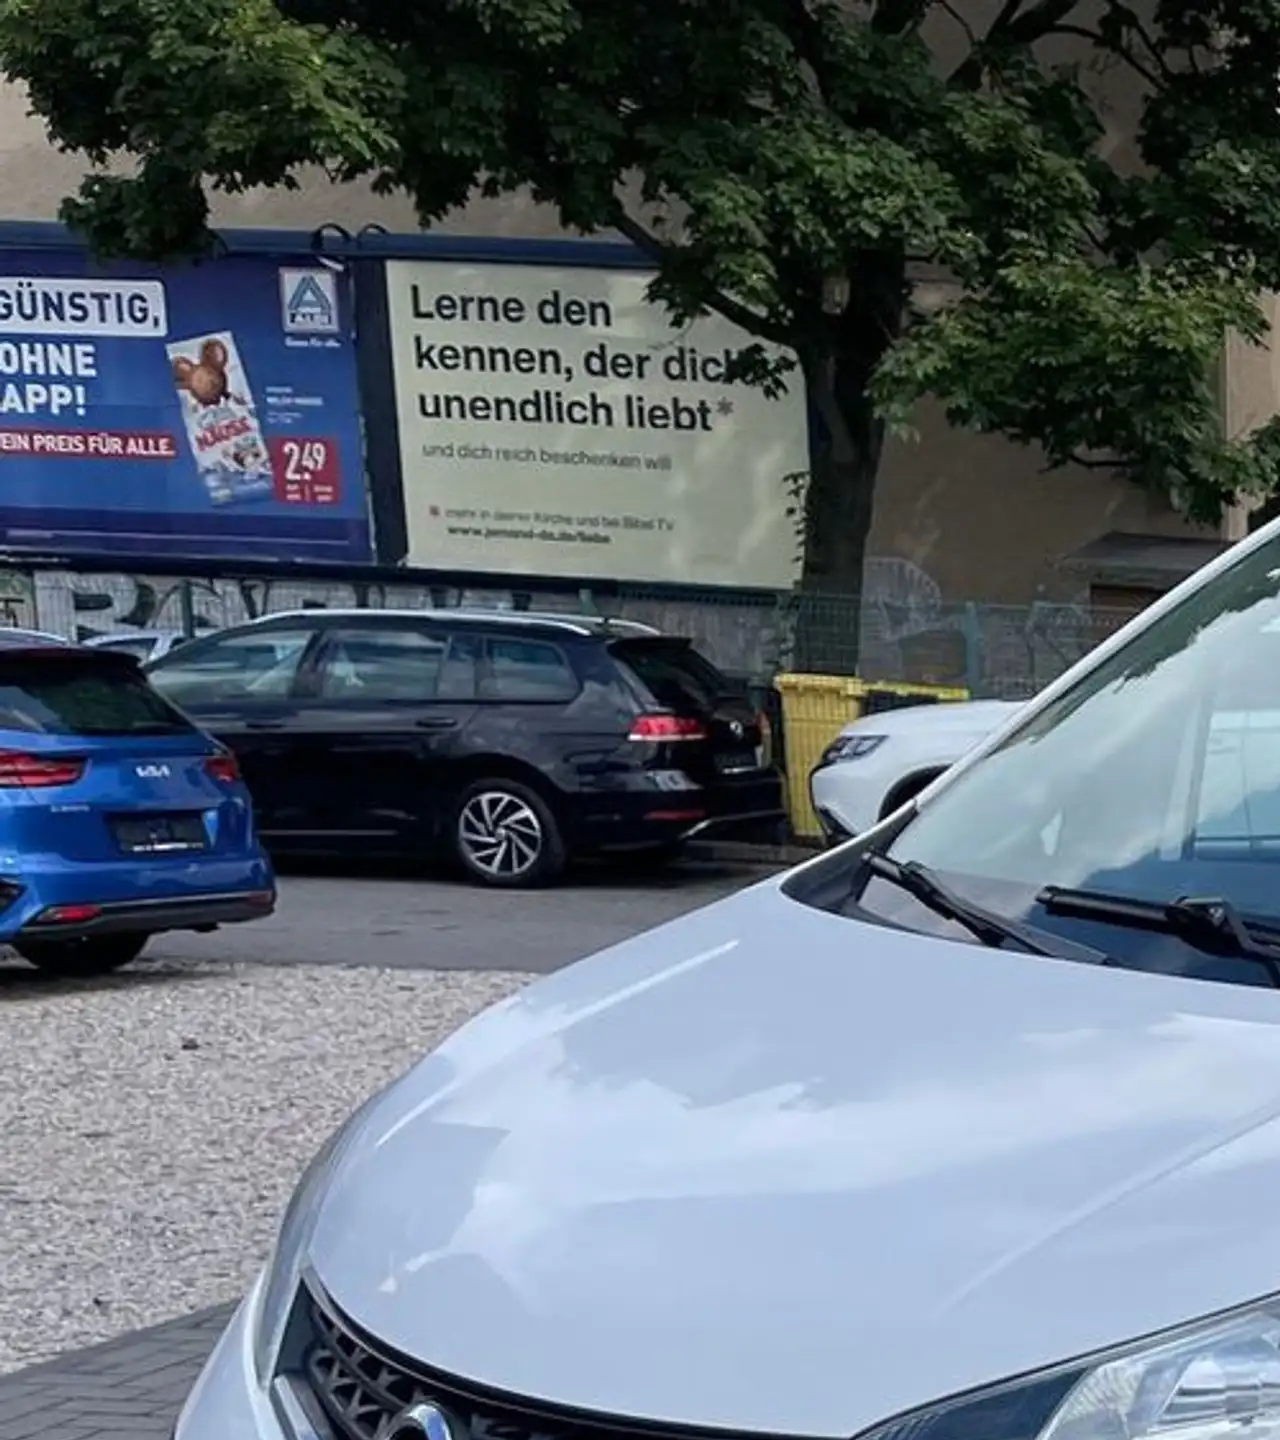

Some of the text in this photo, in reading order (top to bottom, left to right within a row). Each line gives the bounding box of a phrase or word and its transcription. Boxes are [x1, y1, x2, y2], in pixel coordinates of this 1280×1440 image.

[411, 285, 612, 327] Lerne den
[0, 342, 97, 377] OHNE
[414, 335, 574, 382] kennen,
[584, 343, 651, 379] der
[0, 383, 86, 416] APP!
[418, 391, 613, 427] unendlich
[33, 434, 86, 453] PREIS
[88, 432, 124, 454] FÜR
[422, 443, 454, 458] und
[457, 445, 492, 460] dich
[496, 447, 536, 462] reich
[540, 448, 641, 467] beschenken
